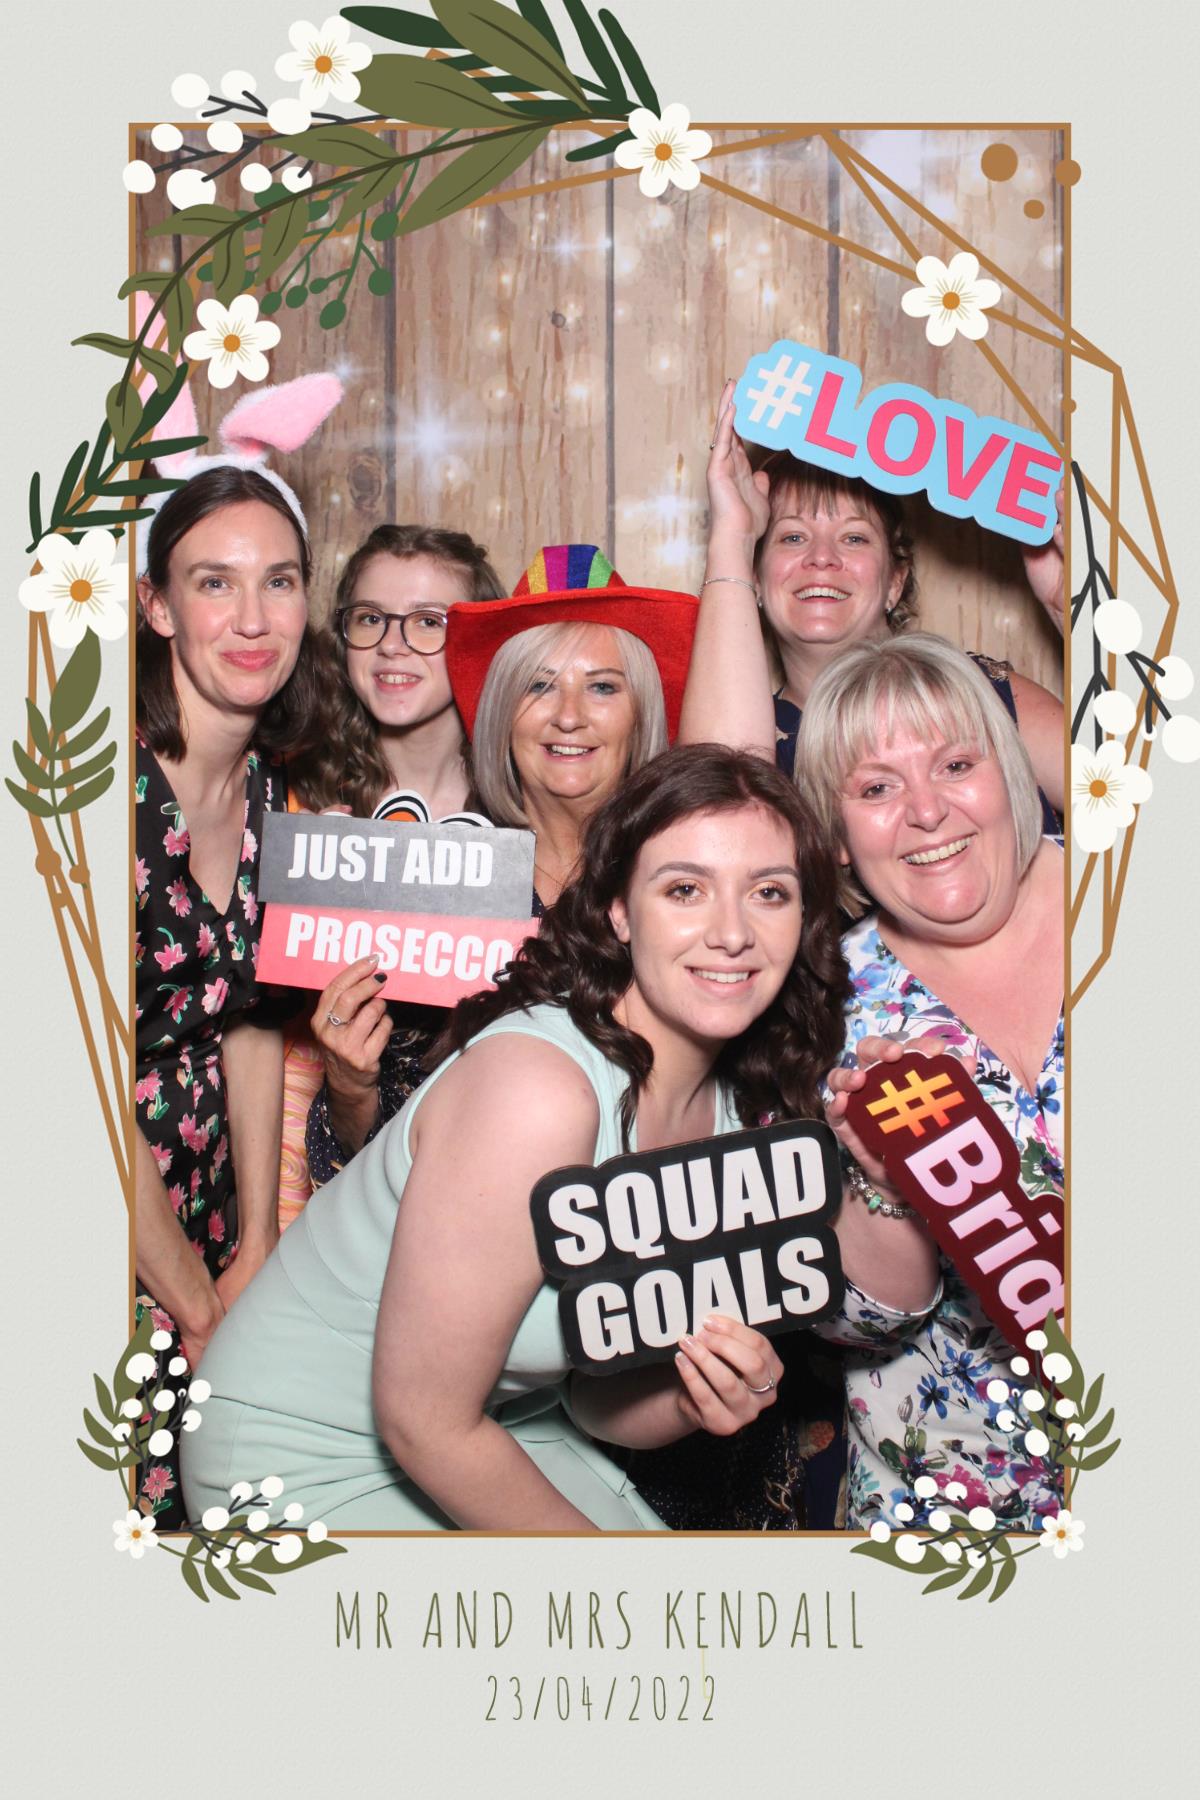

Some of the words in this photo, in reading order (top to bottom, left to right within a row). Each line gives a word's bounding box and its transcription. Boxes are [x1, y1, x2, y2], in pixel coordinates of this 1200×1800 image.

[746, 354, 1062, 529] #LOVE
[288, 833, 395, 882] JUST
[401, 838, 493, 887] ADD
[285, 912, 514, 985] PROSECCO
[548, 1136, 827, 1266] SQUAD
[866, 1069, 1064, 1333] #Brid
[576, 1236, 830, 1361] GOALS
